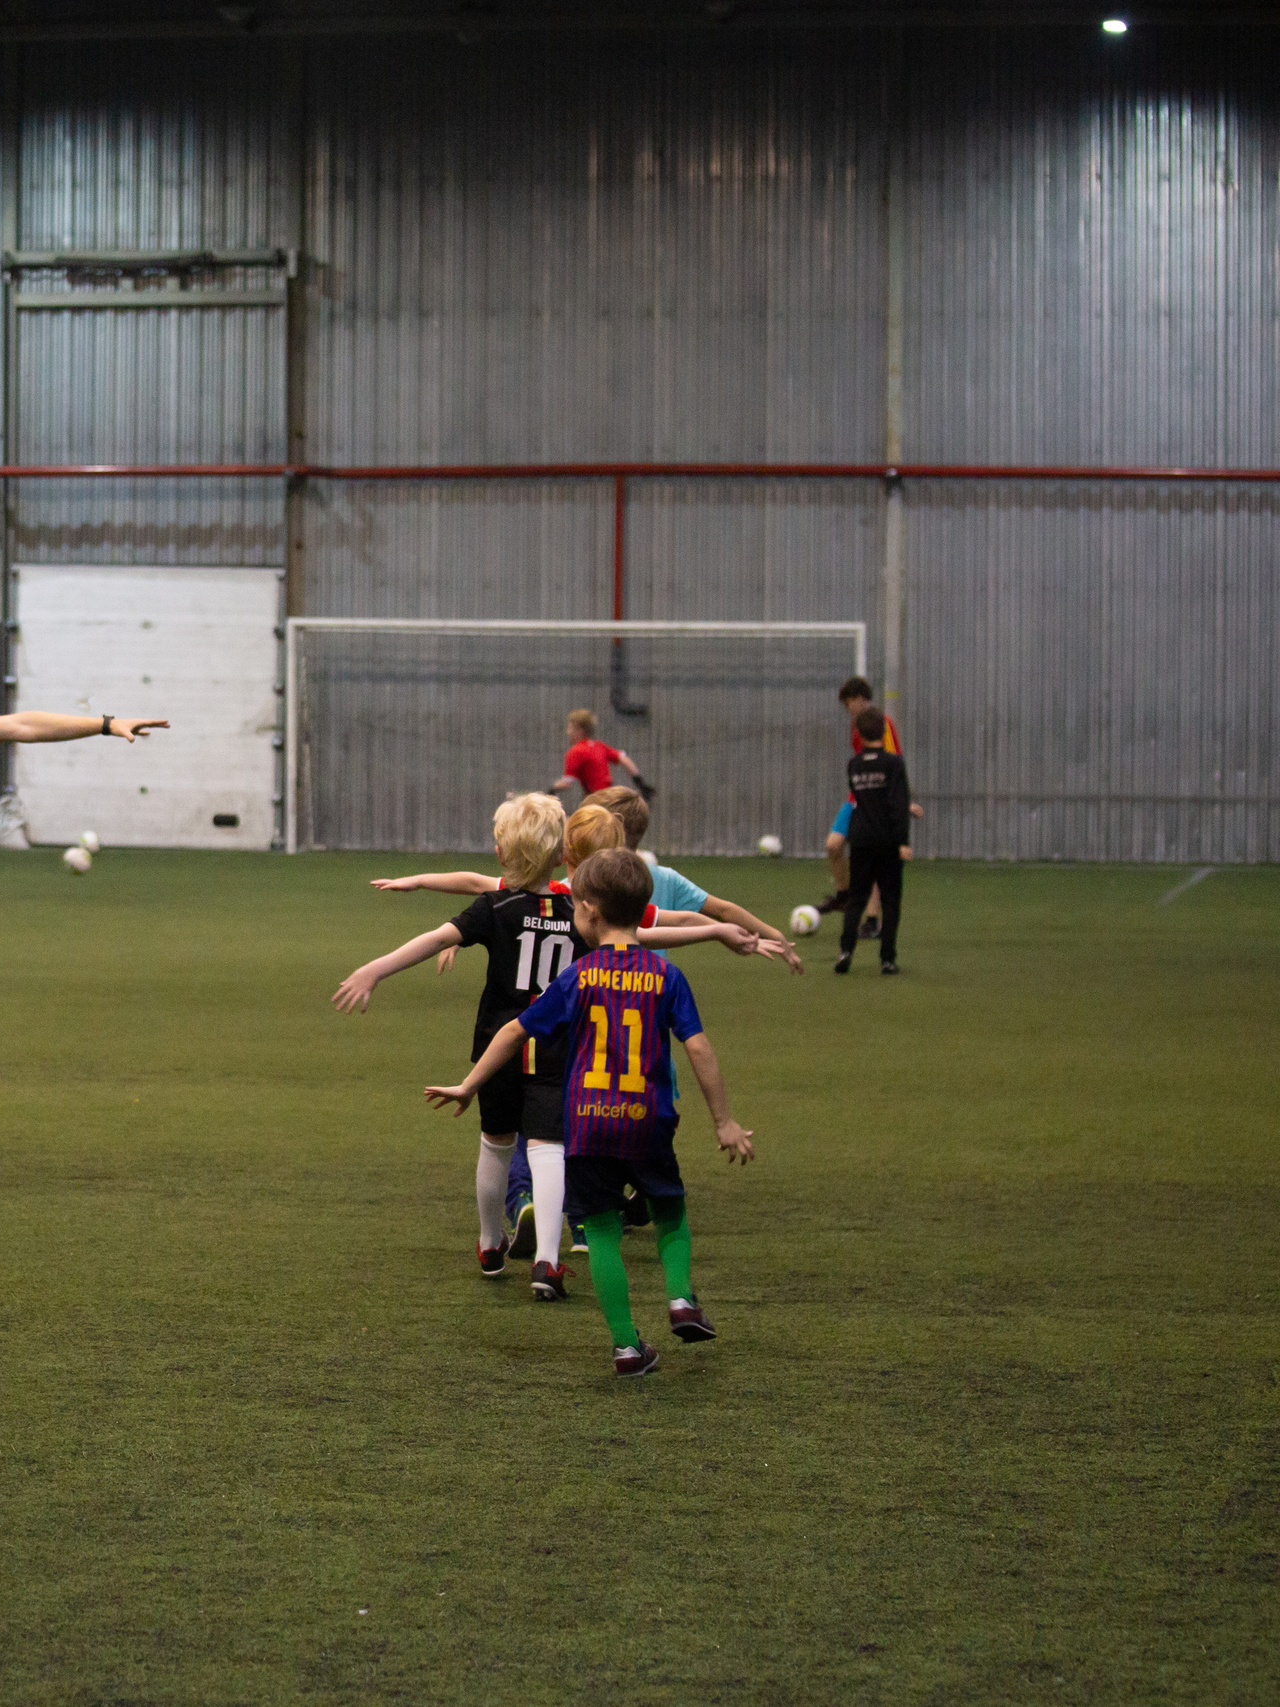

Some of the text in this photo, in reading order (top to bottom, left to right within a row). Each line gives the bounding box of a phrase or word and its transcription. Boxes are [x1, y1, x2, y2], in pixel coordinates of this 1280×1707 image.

[523, 916, 571, 932] BELGIUM
[516, 931, 574, 992] 10
[579, 967, 664, 995] SUMENKOV
[583, 1005, 646, 1093] 11
[577, 1100, 627, 1118] unicef
